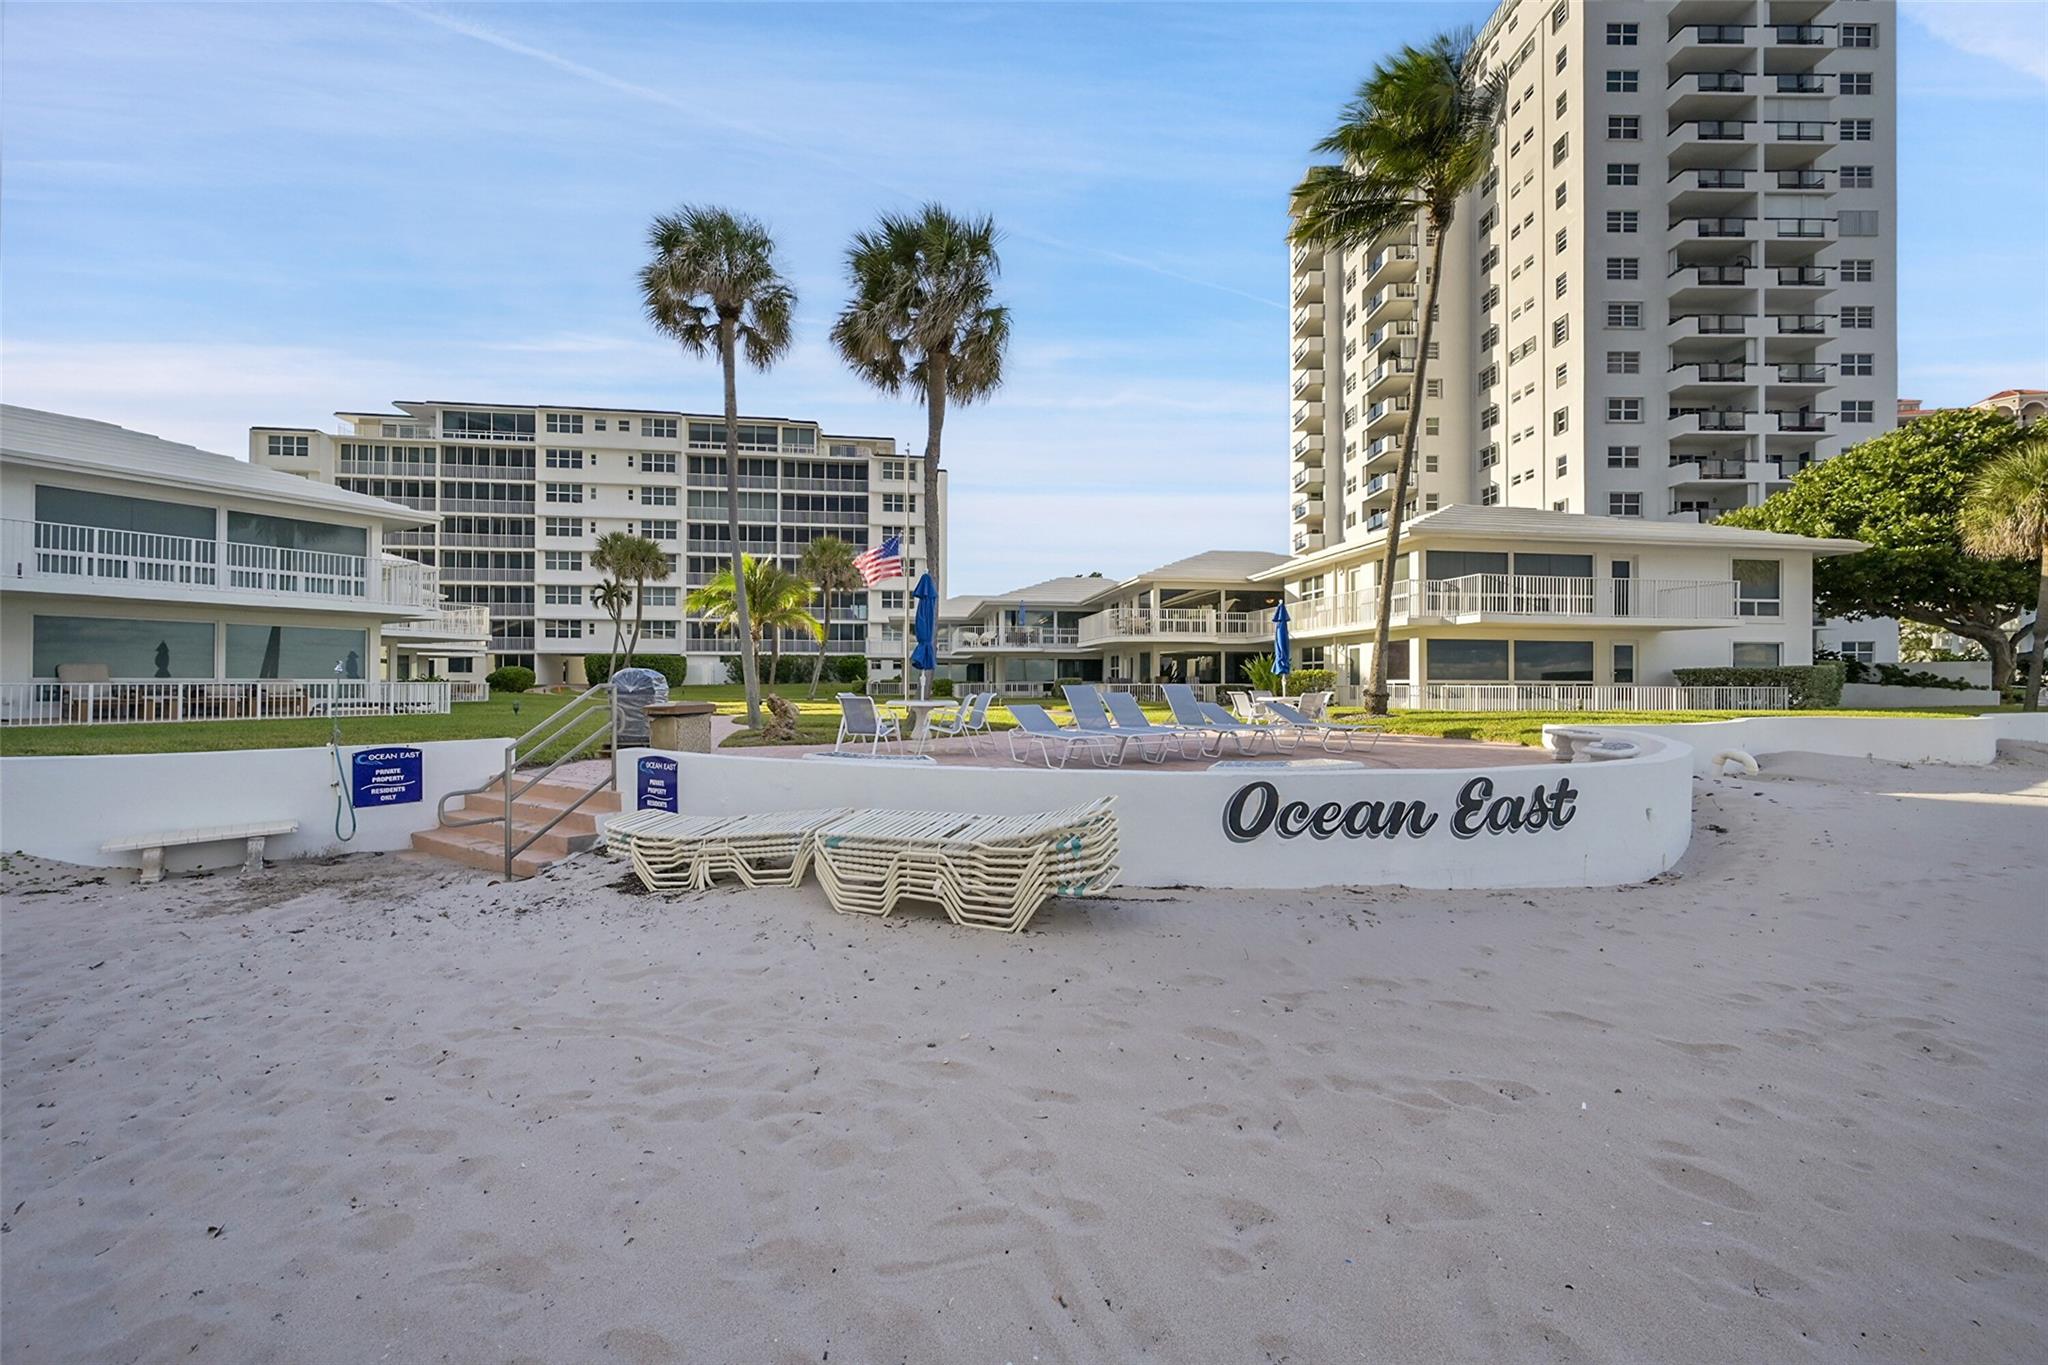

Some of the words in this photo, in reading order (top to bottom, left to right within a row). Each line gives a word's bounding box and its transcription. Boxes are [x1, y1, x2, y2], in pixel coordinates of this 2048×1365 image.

[368, 753, 398, 761] OCEAN
[400, 751, 421, 759] EAST
[645, 761, 663, 770] OCEAN
[663, 763, 677, 771] EAST
[372, 775, 405, 783] PROPERTY
[371, 786, 406, 795] RESIDENTS
[1222, 780, 1438, 843] Ocean
[1450, 776, 1579, 839] East
